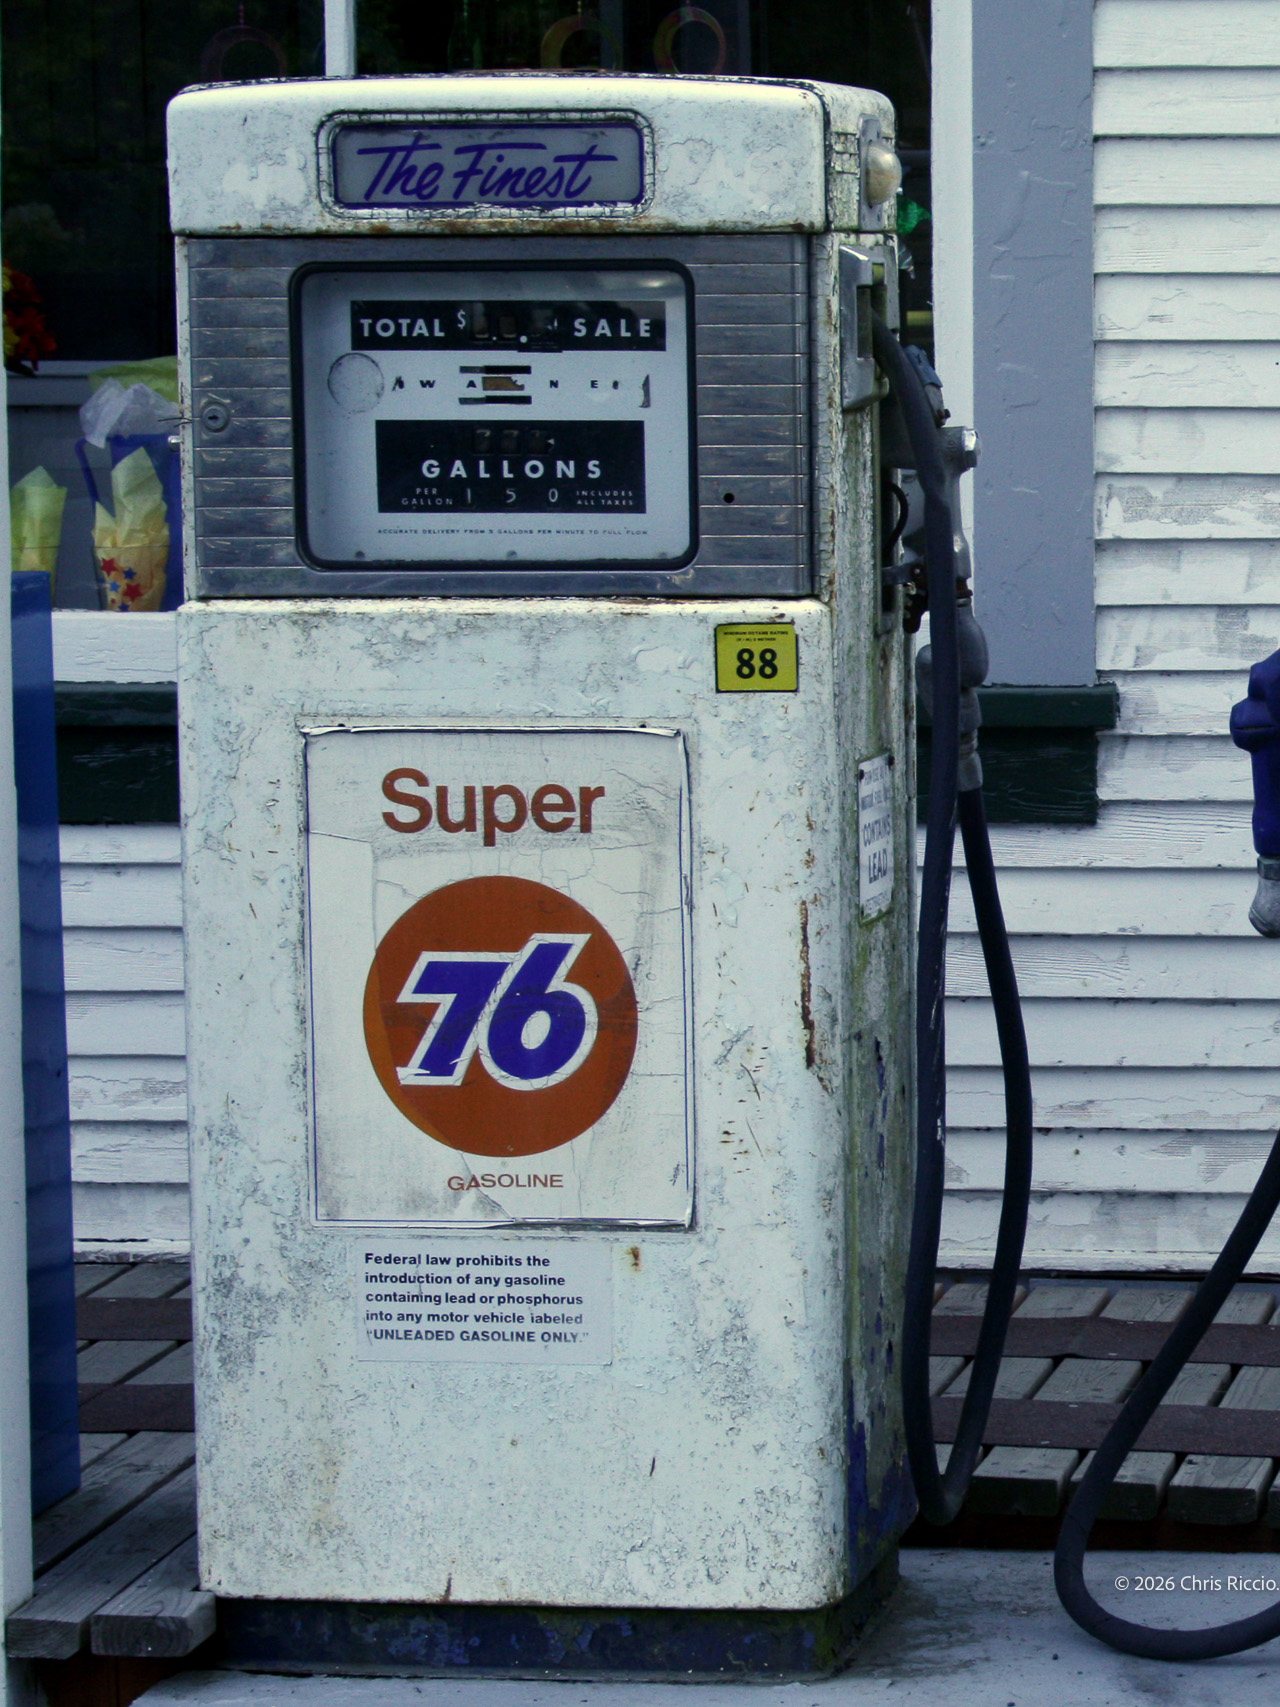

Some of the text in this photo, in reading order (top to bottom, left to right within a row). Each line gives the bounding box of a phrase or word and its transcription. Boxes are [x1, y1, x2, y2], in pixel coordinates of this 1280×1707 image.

[357, 131, 618, 201] The Finest
[360, 308, 652, 338] TOTAL $ SALE
[421, 459, 602, 479] GALLONS
[416, 487, 438, 496] PER
[401, 497, 453, 506] GALLON
[736, 648, 778, 679] 88
[381, 767, 605, 847] Super
[862, 813, 891, 847] CONTAINS
[868, 848, 888, 885] LEAD
[398, 934, 597, 1090] 76
[447, 1172, 564, 1191] GASOLINE
[364, 1252, 550, 1268] Federal law prohibits the
[364, 1272, 566, 1288] introduction of any gasoline
[365, 1291, 583, 1307] containing lead or phosphorus
[366, 1310, 583, 1325] into any motor vehicle labeled
[459, 1330, 536, 1343] GASOLINE
